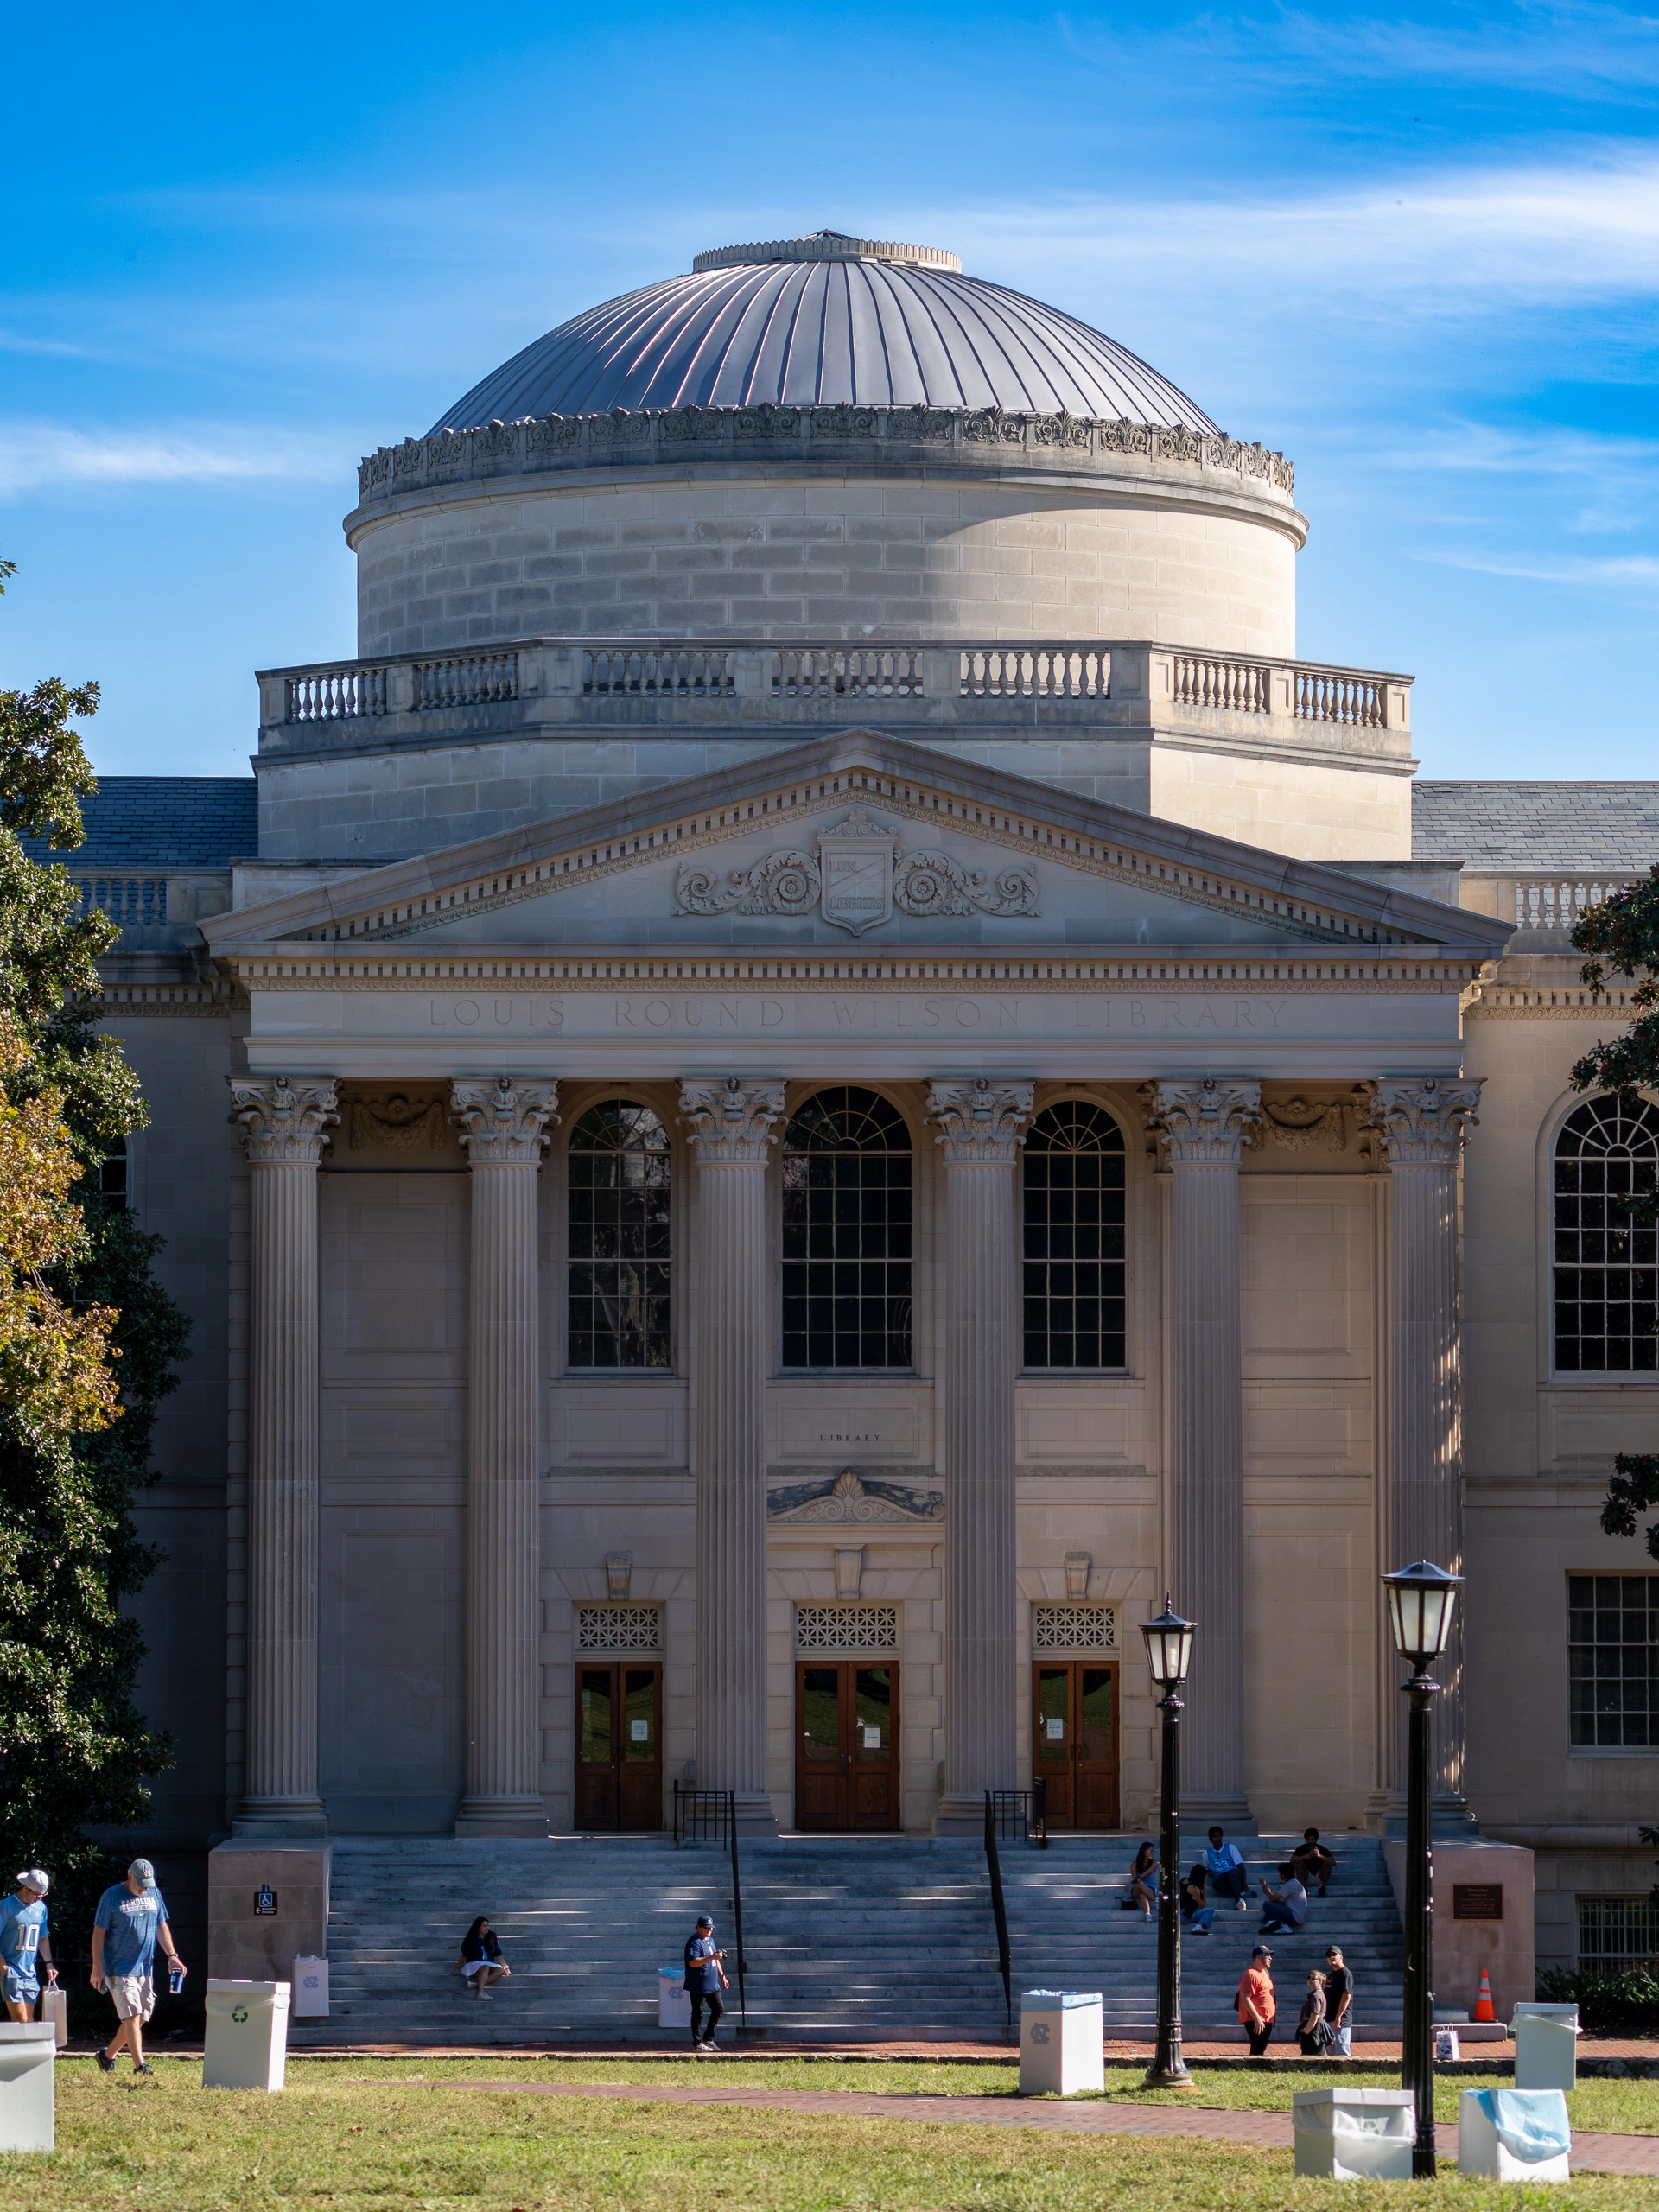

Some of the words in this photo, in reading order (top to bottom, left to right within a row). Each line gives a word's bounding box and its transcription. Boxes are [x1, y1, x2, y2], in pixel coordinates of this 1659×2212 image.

[830, 861, 857, 873] LUX
[830, 897, 885, 909] LIBERTAS
[428, 999, 564, 1026] LOUIS
[613, 1000, 784, 1027] ROUND
[828, 1000, 1020, 1027] WILSON
[1073, 1001, 1290, 1027] LIBRARY
[1215, 1860, 1229, 1871] 23
[121, 1897, 156, 1908] CAROLINA
[16, 1923, 40, 1952] 10
